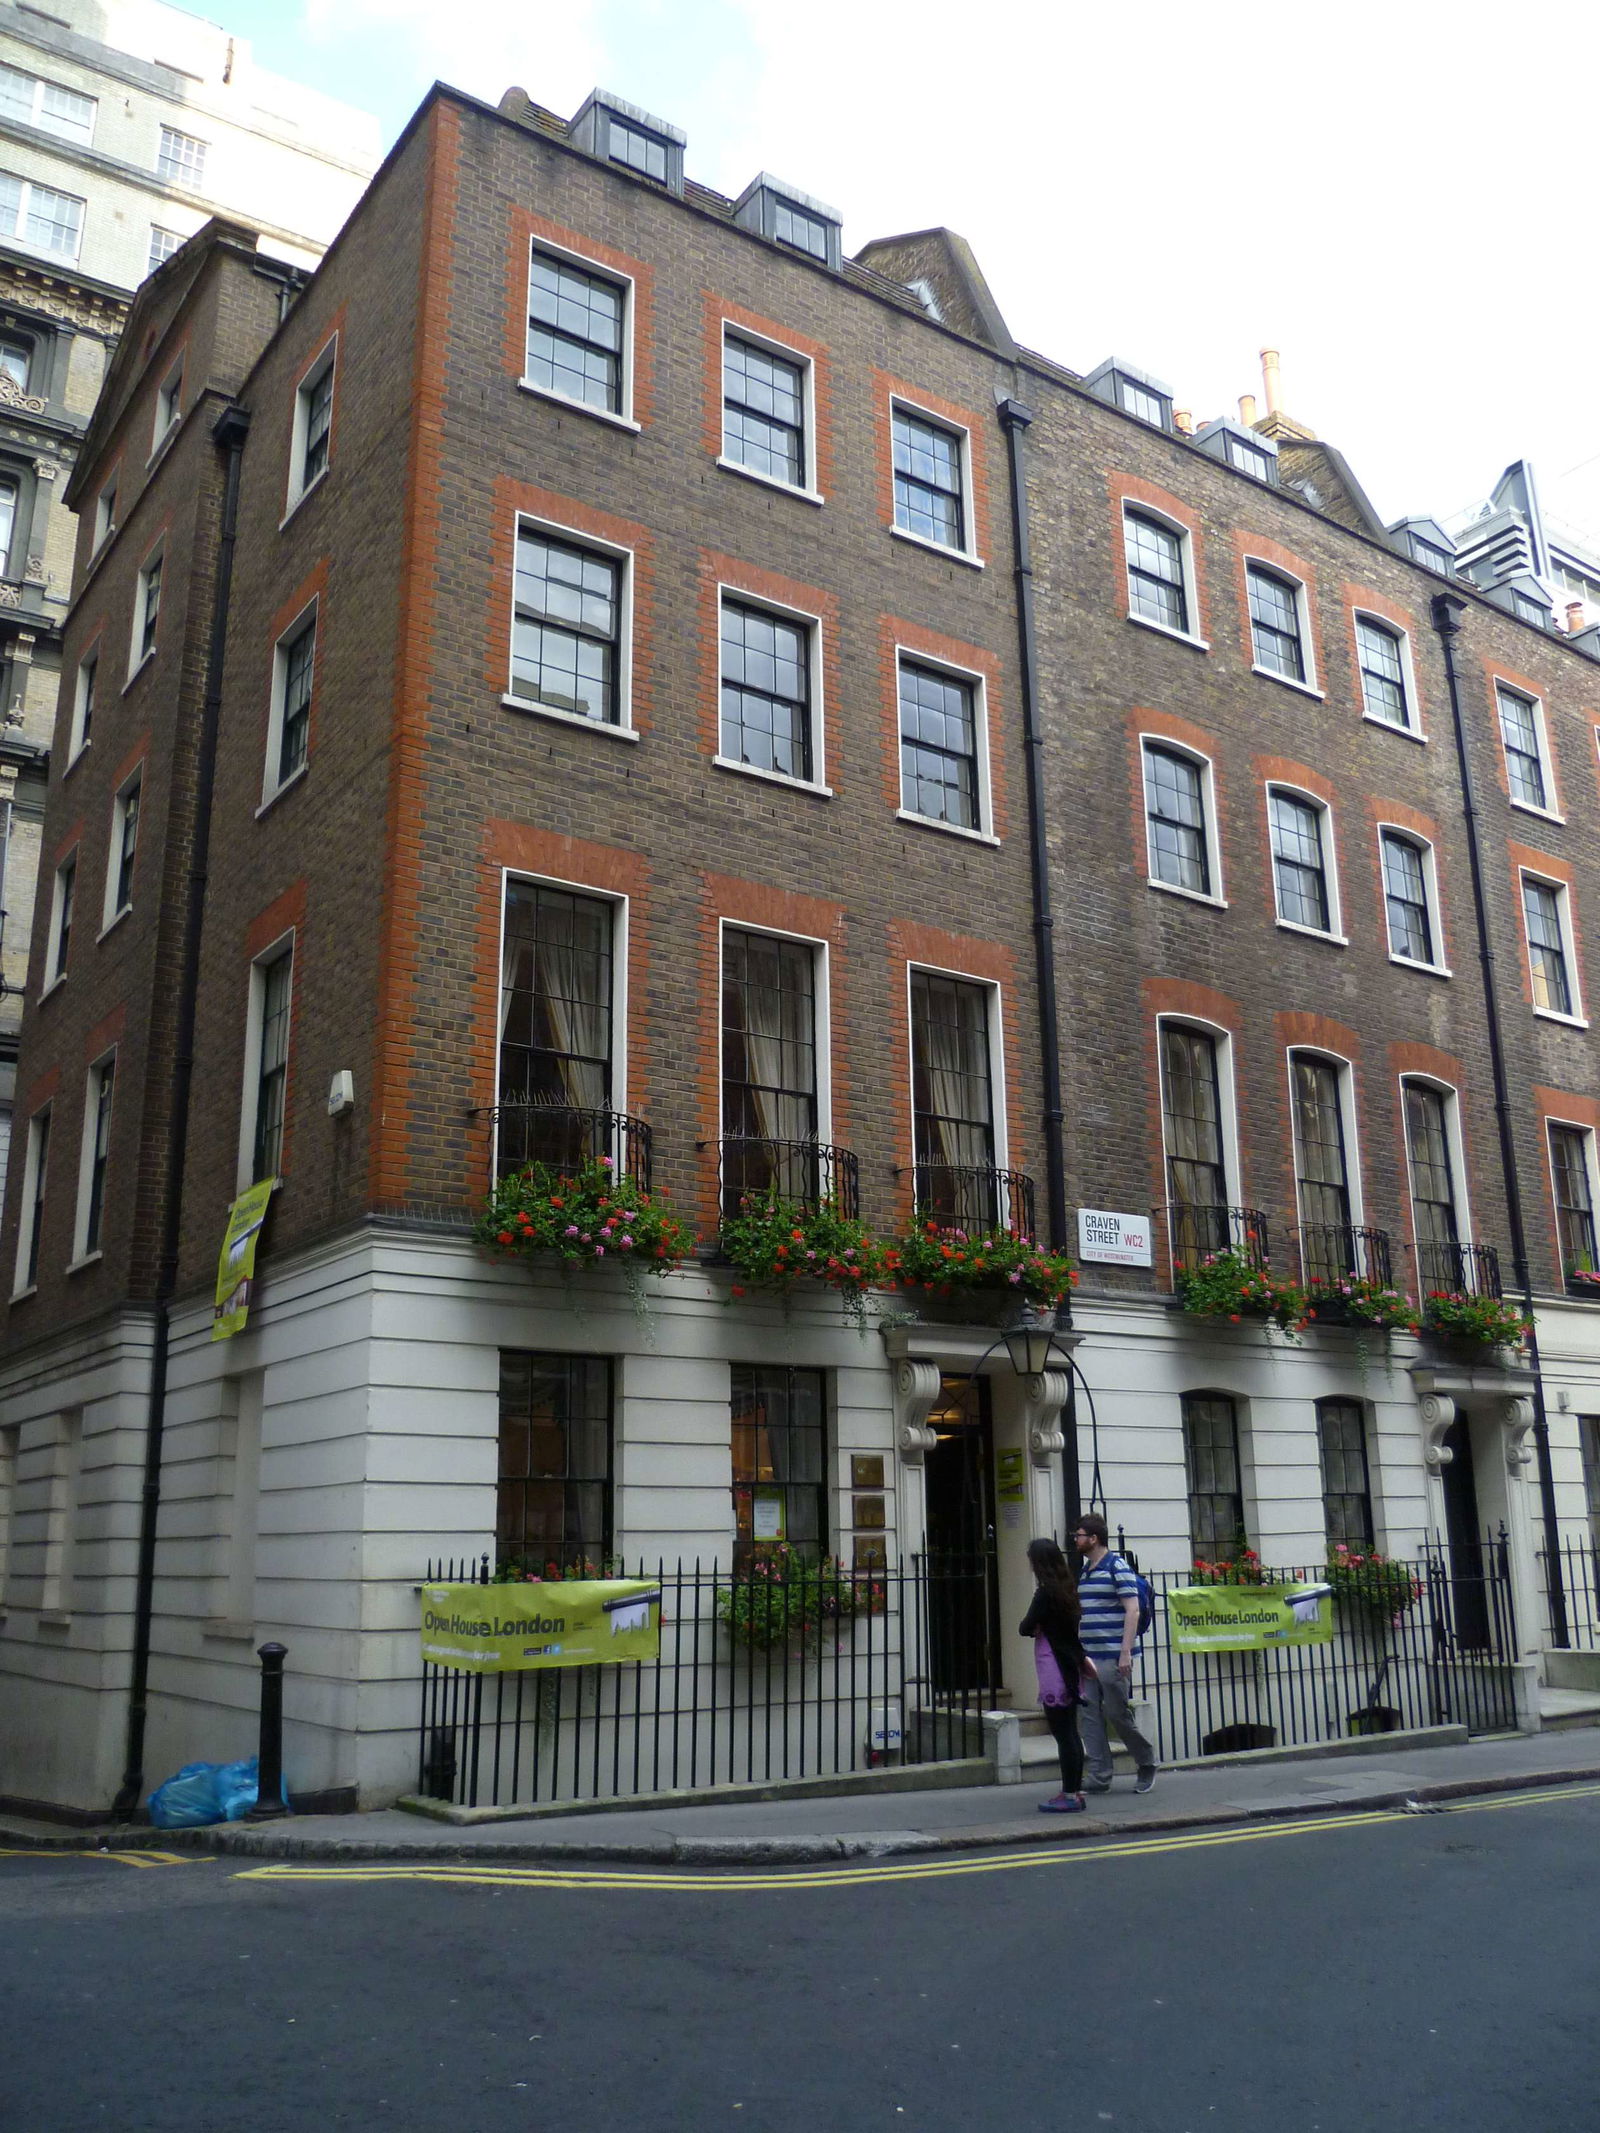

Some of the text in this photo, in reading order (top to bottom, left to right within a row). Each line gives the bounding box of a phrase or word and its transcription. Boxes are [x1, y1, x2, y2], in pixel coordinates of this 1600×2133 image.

[1085, 1214, 1120, 1231] CRAVEN
[1086, 1229, 1144, 1248] STREET WC2
[424, 1610, 450, 1636] Open
[450, 1613, 491, 1637] House
[493, 1612, 565, 1636] London
[1175, 1607, 1279, 1631] Open House London
[875, 1729, 900, 1739] SEOM
